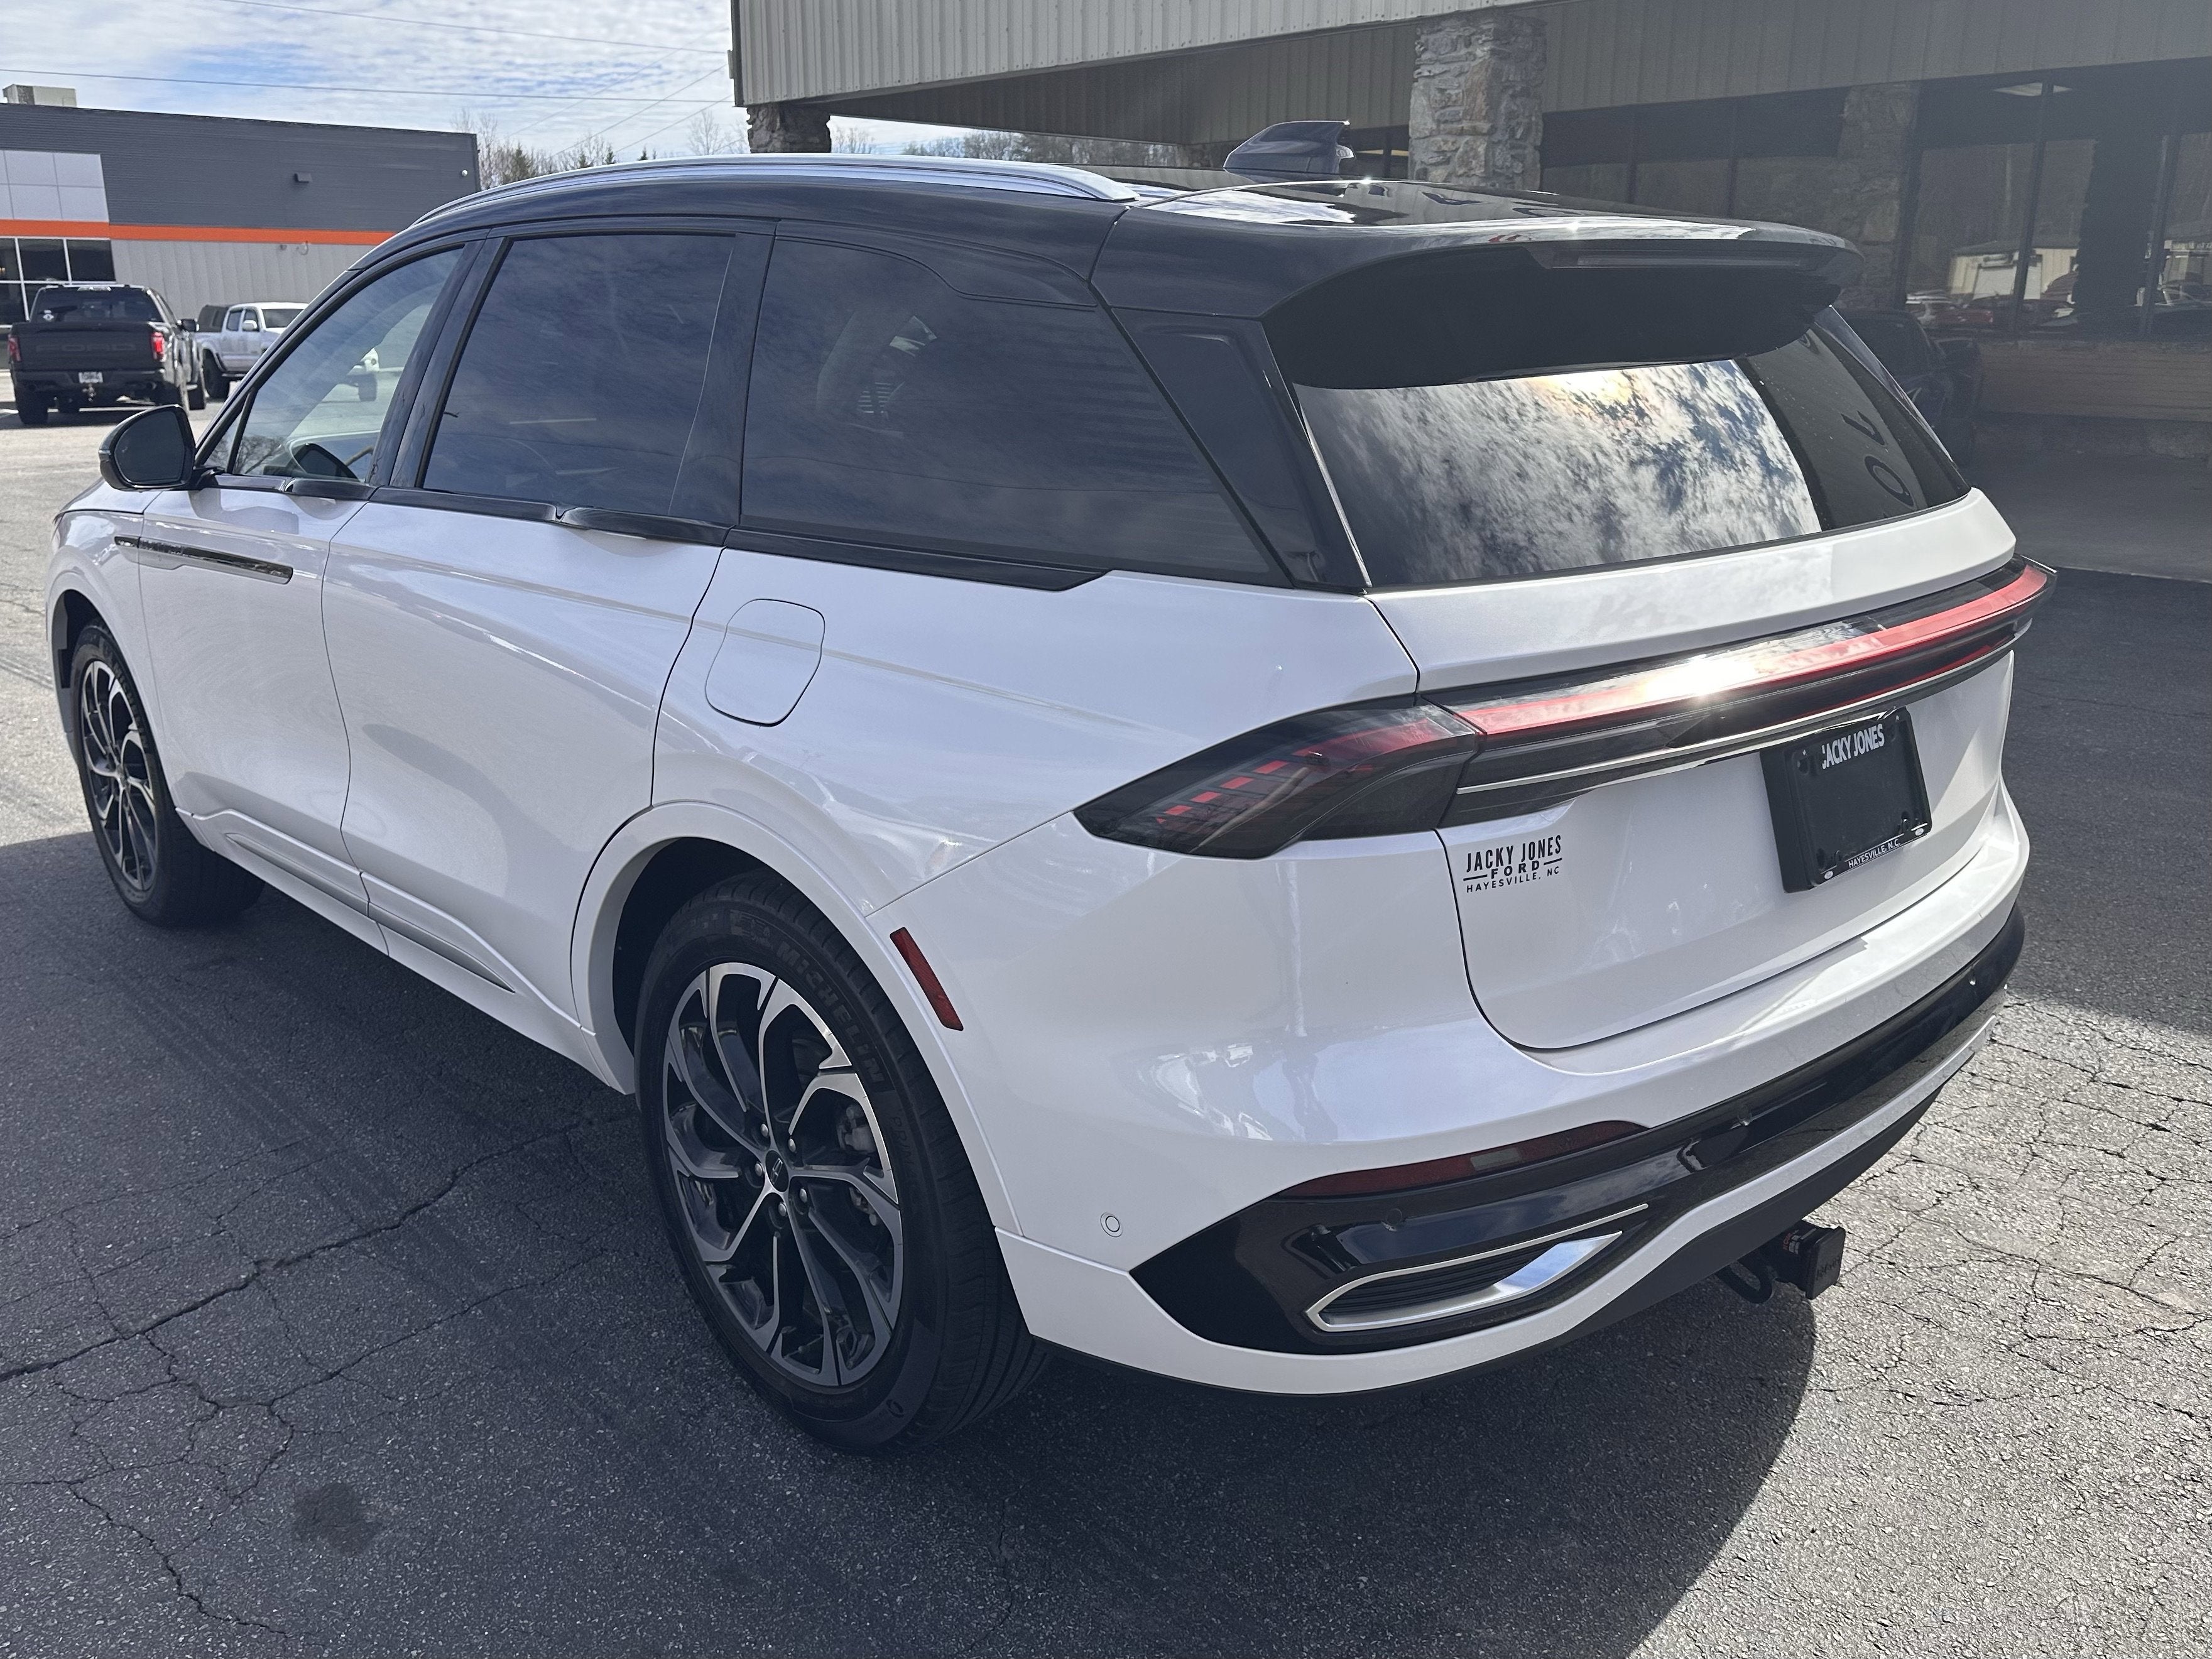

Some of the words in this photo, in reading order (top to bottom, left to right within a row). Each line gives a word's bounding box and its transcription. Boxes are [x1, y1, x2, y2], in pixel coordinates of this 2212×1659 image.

[1822, 734, 1852, 769] JACKY
[1853, 724, 1885, 757] JONES
[1466, 846, 1514, 873] JACKY
[1521, 835, 1561, 862] JONES
[1888, 839, 1900, 849] N.C.
[1466, 872, 1541, 893] HAYESVILLE,
[1547, 866, 1559, 876] NC
[1491, 860, 1540, 879] FORD
[776, 940, 885, 1083] MICHELIN
